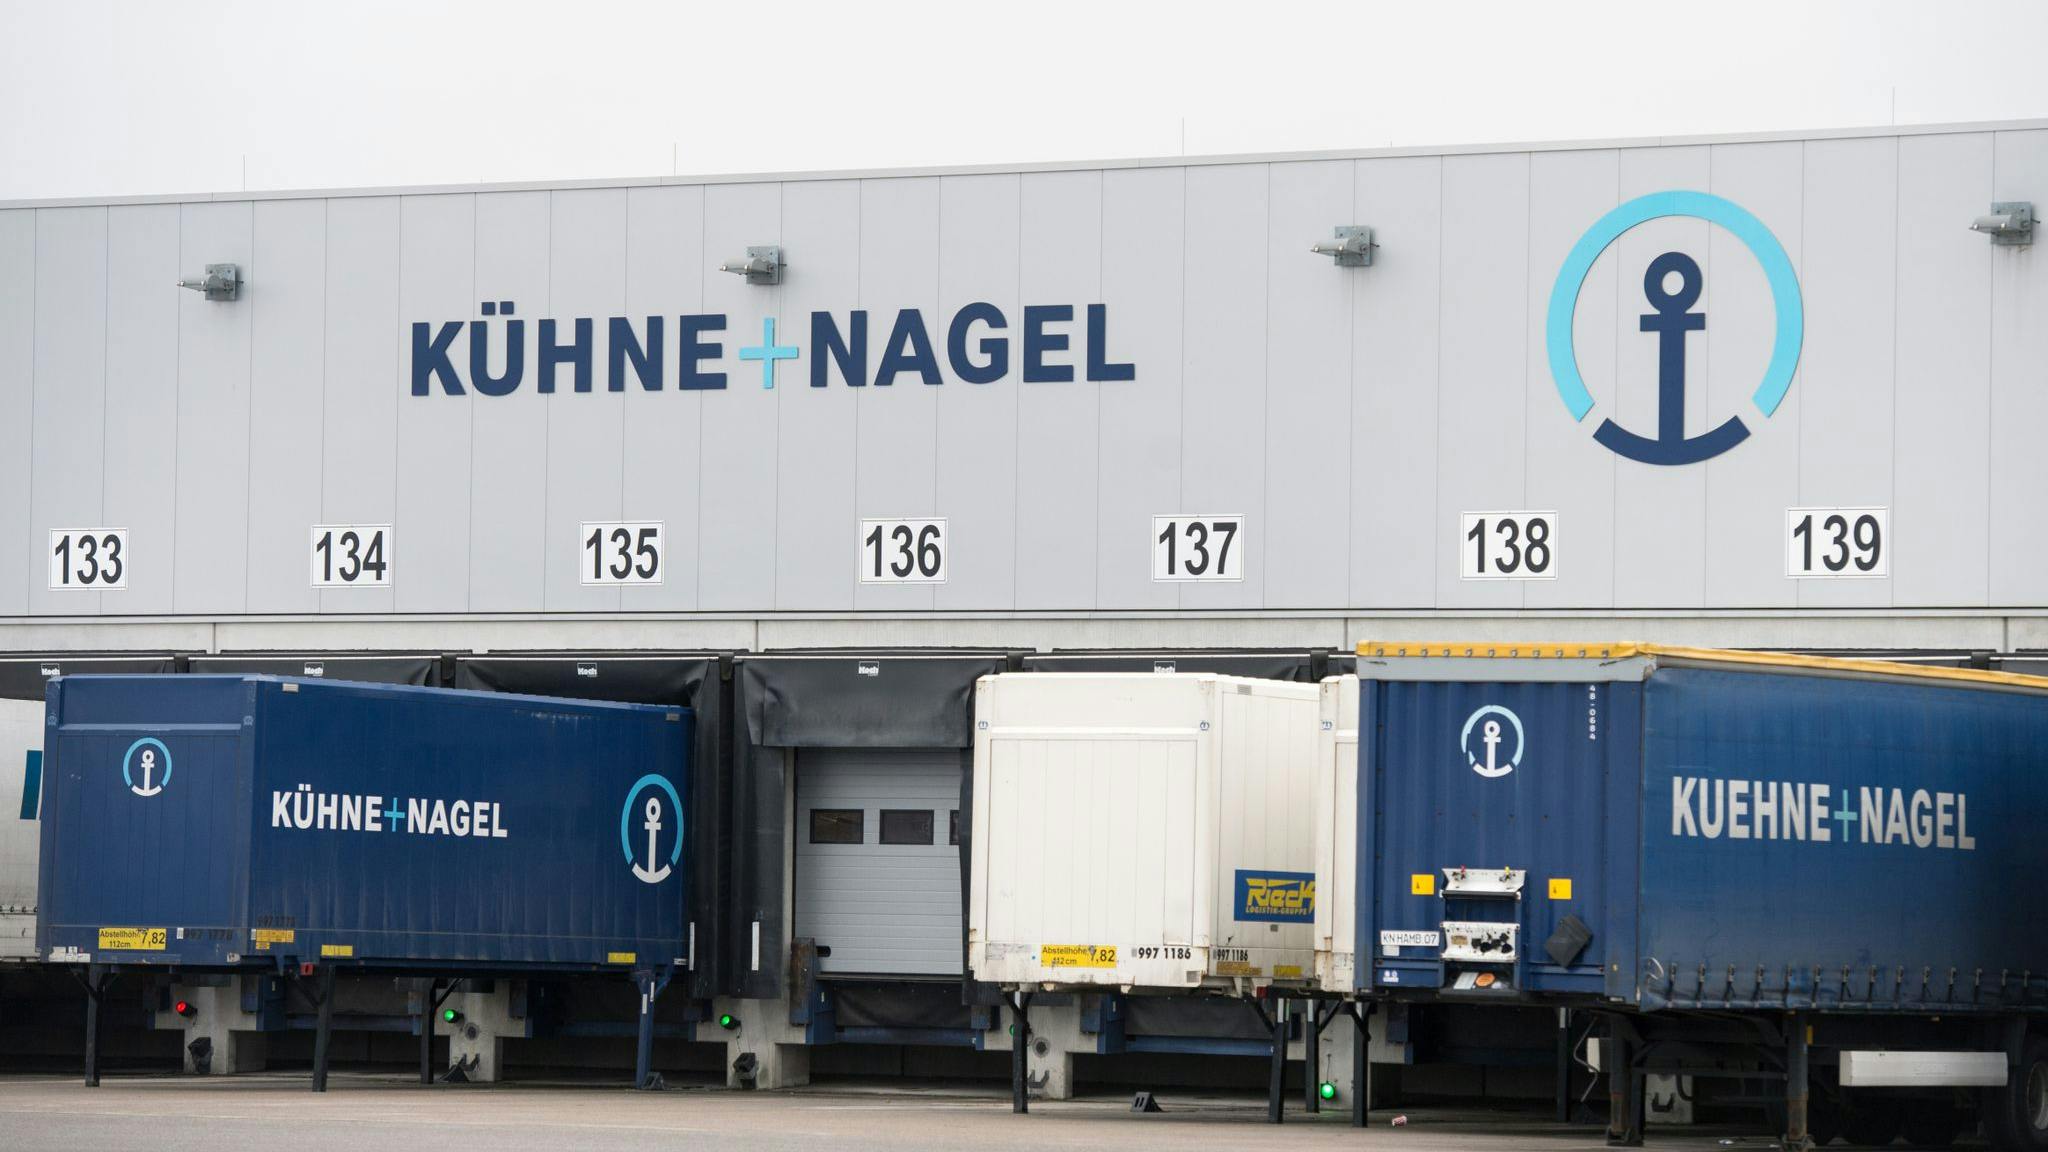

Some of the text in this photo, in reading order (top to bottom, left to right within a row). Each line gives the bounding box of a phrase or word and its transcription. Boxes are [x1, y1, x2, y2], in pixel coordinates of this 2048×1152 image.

[55, 534, 123, 585] 133
[316, 531, 387, 582] 134
[586, 528, 659, 579] 135
[866, 525, 942, 578] 136
[1159, 521, 1238, 576] 137
[1468, 517, 1551, 574] 138
[1794, 514, 1881, 572] 139
[1138, 947, 1191, 960] 997 1186
[1217, 949, 1248, 961] 997 1186
[1424, 934, 1437, 944] 07
